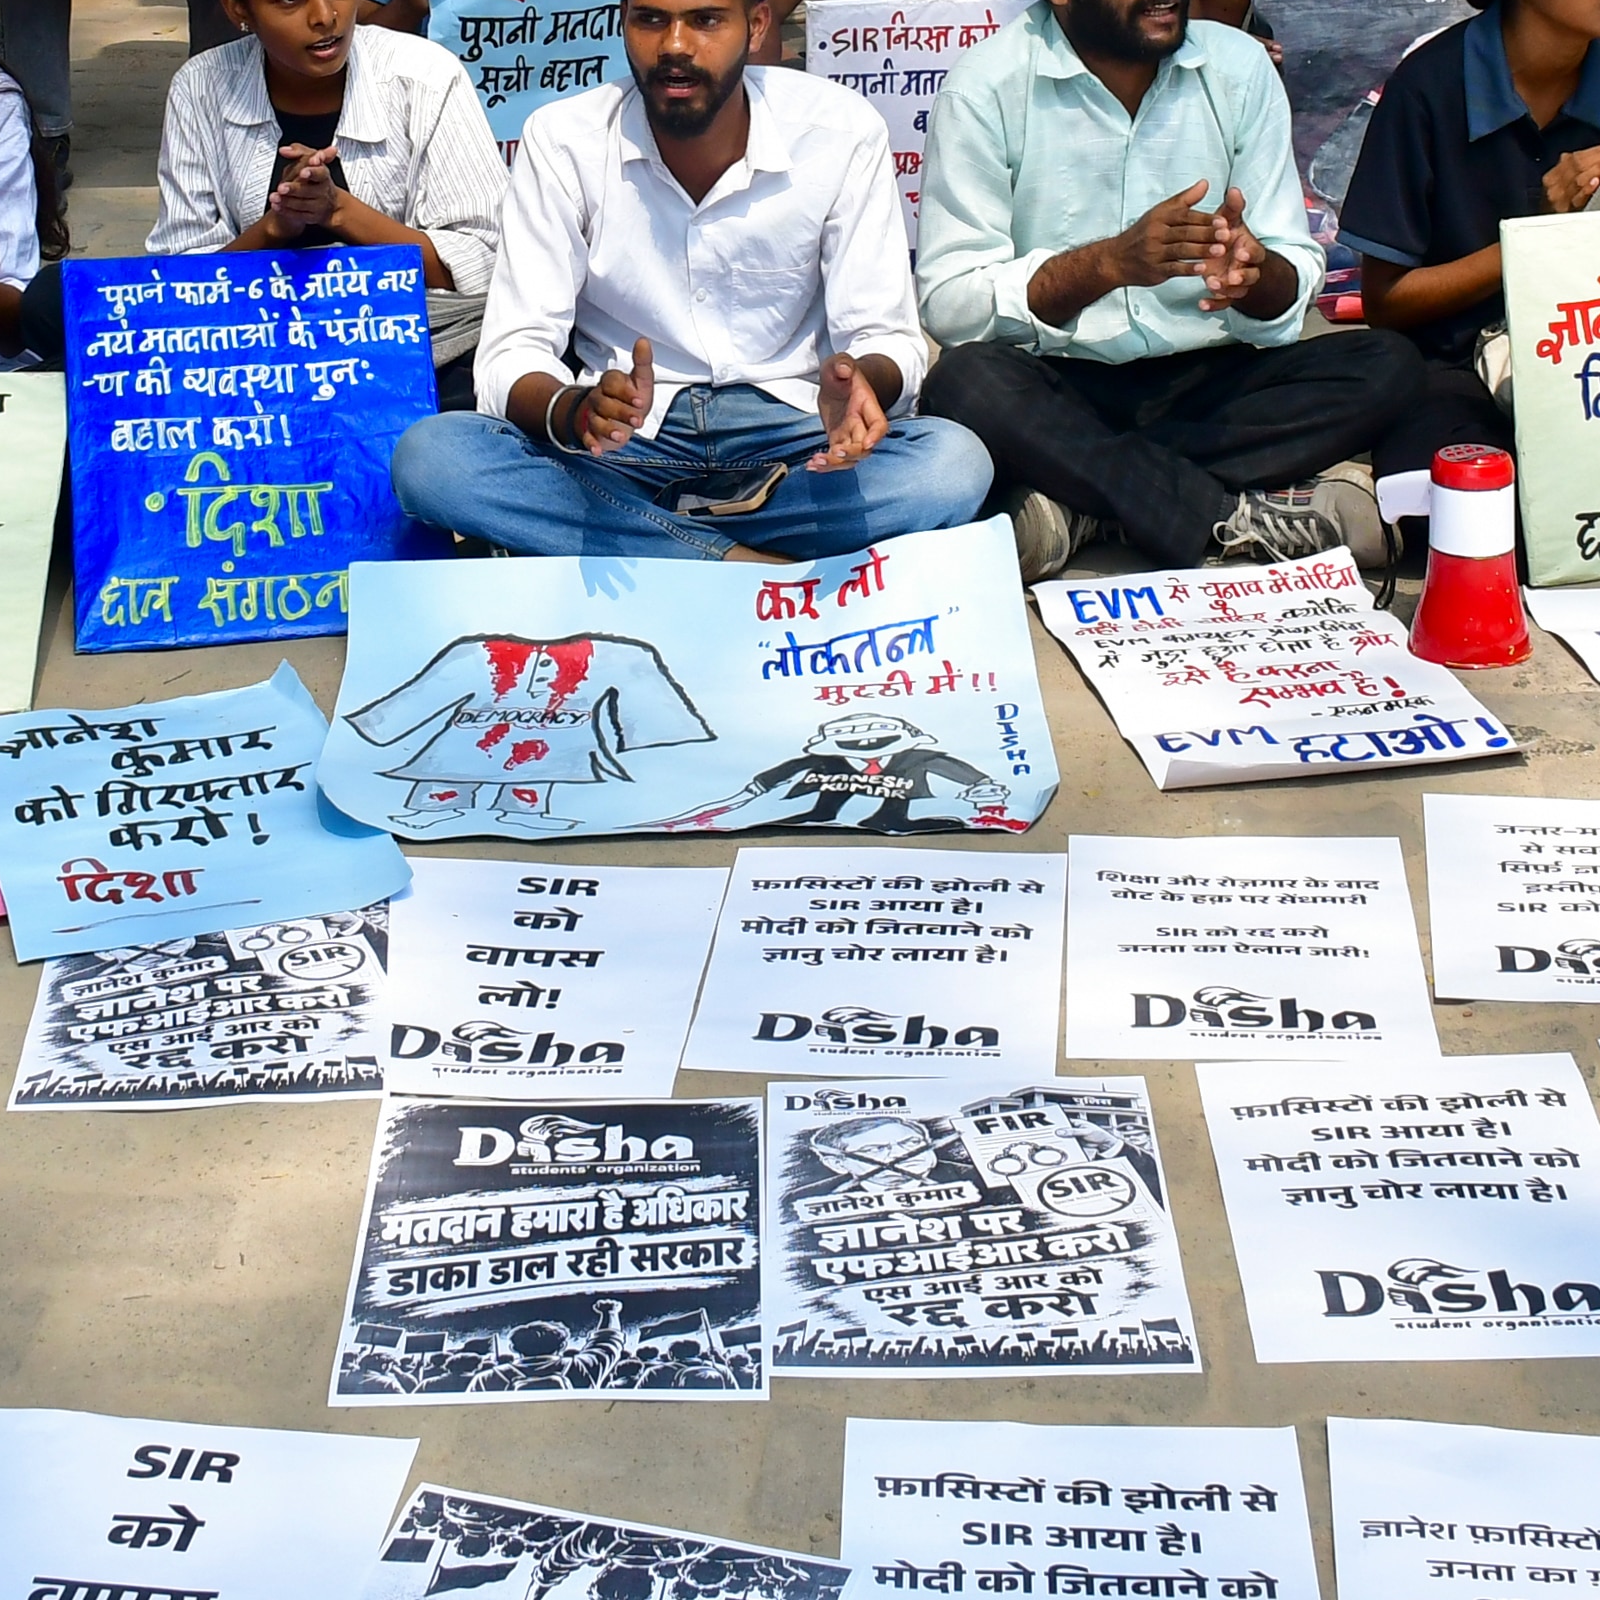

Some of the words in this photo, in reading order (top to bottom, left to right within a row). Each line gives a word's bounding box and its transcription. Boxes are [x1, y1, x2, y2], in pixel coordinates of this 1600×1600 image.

[458, 6, 543, 62] पुरानी
[832, 28, 878, 57] SIR
[476, 55, 534, 107] सूची
[540, 56, 609, 92] बहाल
[112, 417, 201, 451] बहाल
[213, 400, 291, 450] करो!
[176, 450, 333, 557] दिशा
[757, 578, 821, 621] कर
[838, 548, 888, 606] लो
[1067, 587, 1164, 628] EVM
[454, 708, 586, 728] DEMOCRACY
[1154, 726, 1279, 752] EVM
[1290, 714, 1508, 763] हटाओ!
[804, 771, 914, 791] GYANESH
[820, 782, 908, 800] KUMAR
[110, 806, 269, 850] करो!
[57, 858, 204, 904] दिशा
[518, 877, 599, 896] SIR
[514, 907, 583, 931] को
[951, 898, 982, 915] है।
[467, 945, 604, 967] वापस
[479, 981, 561, 1009] लो!
[390, 1020, 626, 1065] Disha
[452, 1115, 695, 1166] Disha
[974, 1112, 1053, 1134] FIR
[1046, 1171, 1118, 1200] SIR
[381, 1207, 507, 1245] मतदान
[510, 1197, 598, 1240] हमारा
[600, 1186, 627, 1224] है
[632, 1188, 749, 1231] अधिकार
[388, 1257, 480, 1296] डाका
[489, 1253, 558, 1284] डाल
[560, 1237, 630, 1285] रही
[627, 1235, 748, 1276] सरकार
